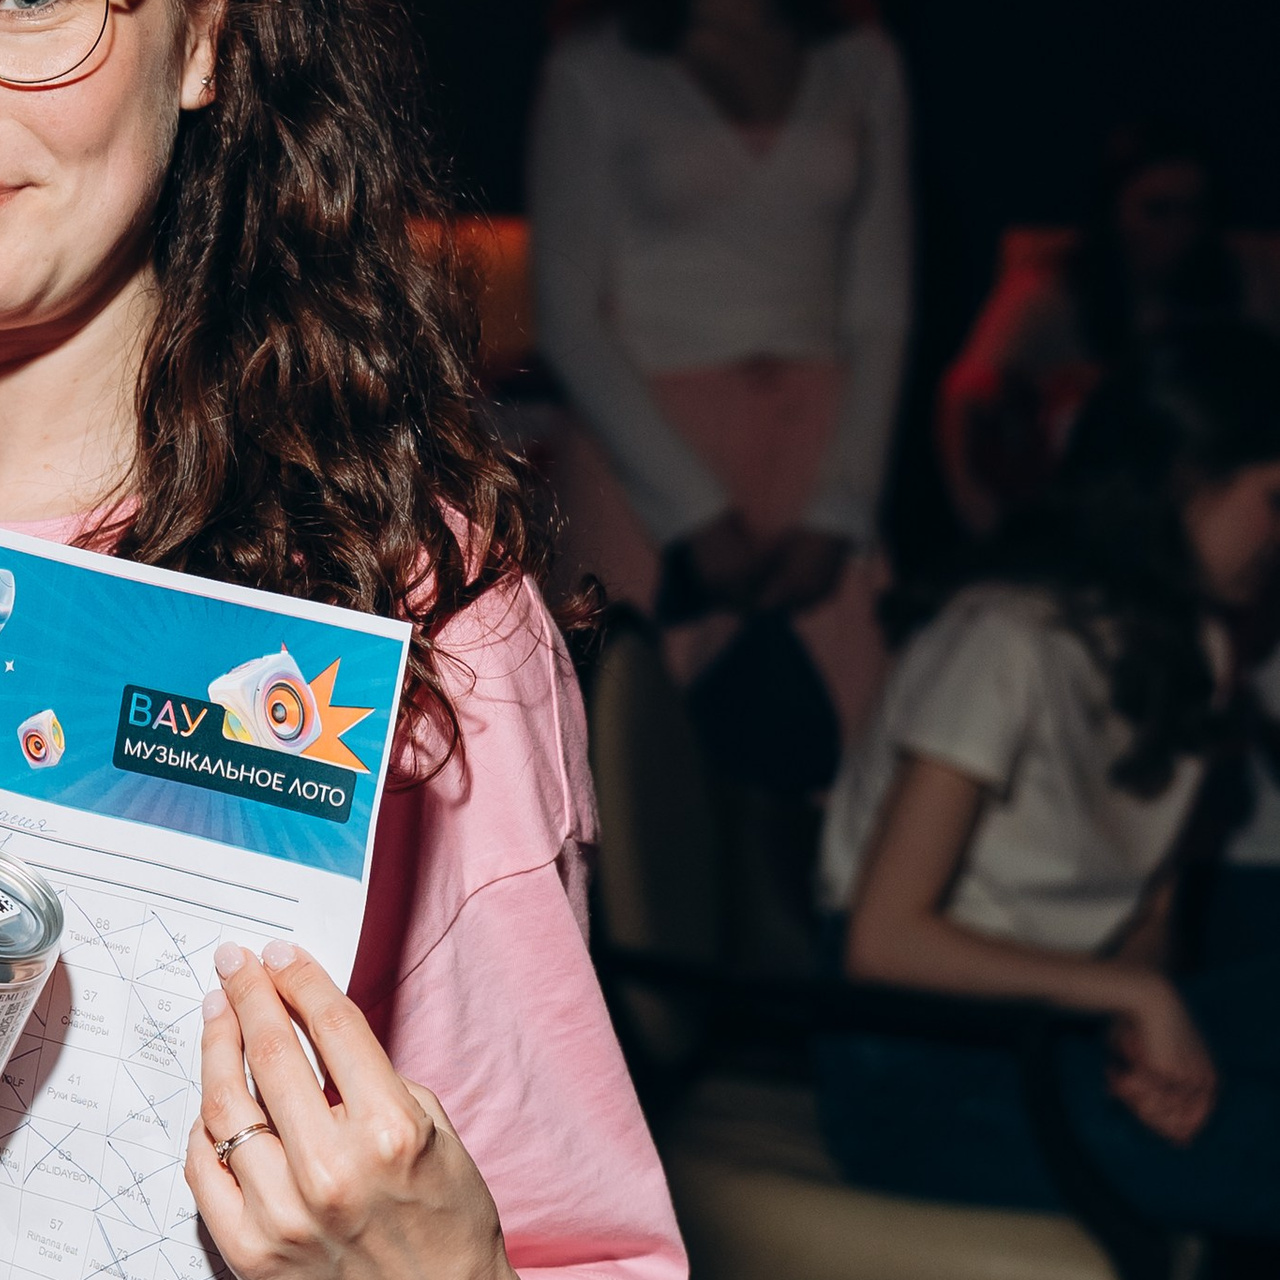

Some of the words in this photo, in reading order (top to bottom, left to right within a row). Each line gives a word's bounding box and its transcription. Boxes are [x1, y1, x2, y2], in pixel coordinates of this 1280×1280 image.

[128, 692, 208, 737] ВАУ
[124, 738, 286, 792] МУЗЫКАЛЬНОЕ
[288, 778, 346, 807] ЛОТО
[95, 917, 110, 931] 88
[69, 930, 100, 947] Танцы
[82, 989, 98, 1003] 37
[157, 999, 172, 1013] 85
[69, 1005, 105, 1023] Ночные
[61, 1015, 109, 1037] Снайперы
[67, 1073, 81, 1086] 41
[46, 1086, 68, 1101] Руки
[148, 1094, 156, 1106] 8
[49, 1218, 64, 1231] 57
[26, 1229, 61, 1251] Rihanna
[62, 1242, 78, 1257] feat
[38, 1246, 63, 1262] Drake
[188, 1255, 203, 1269] 24
